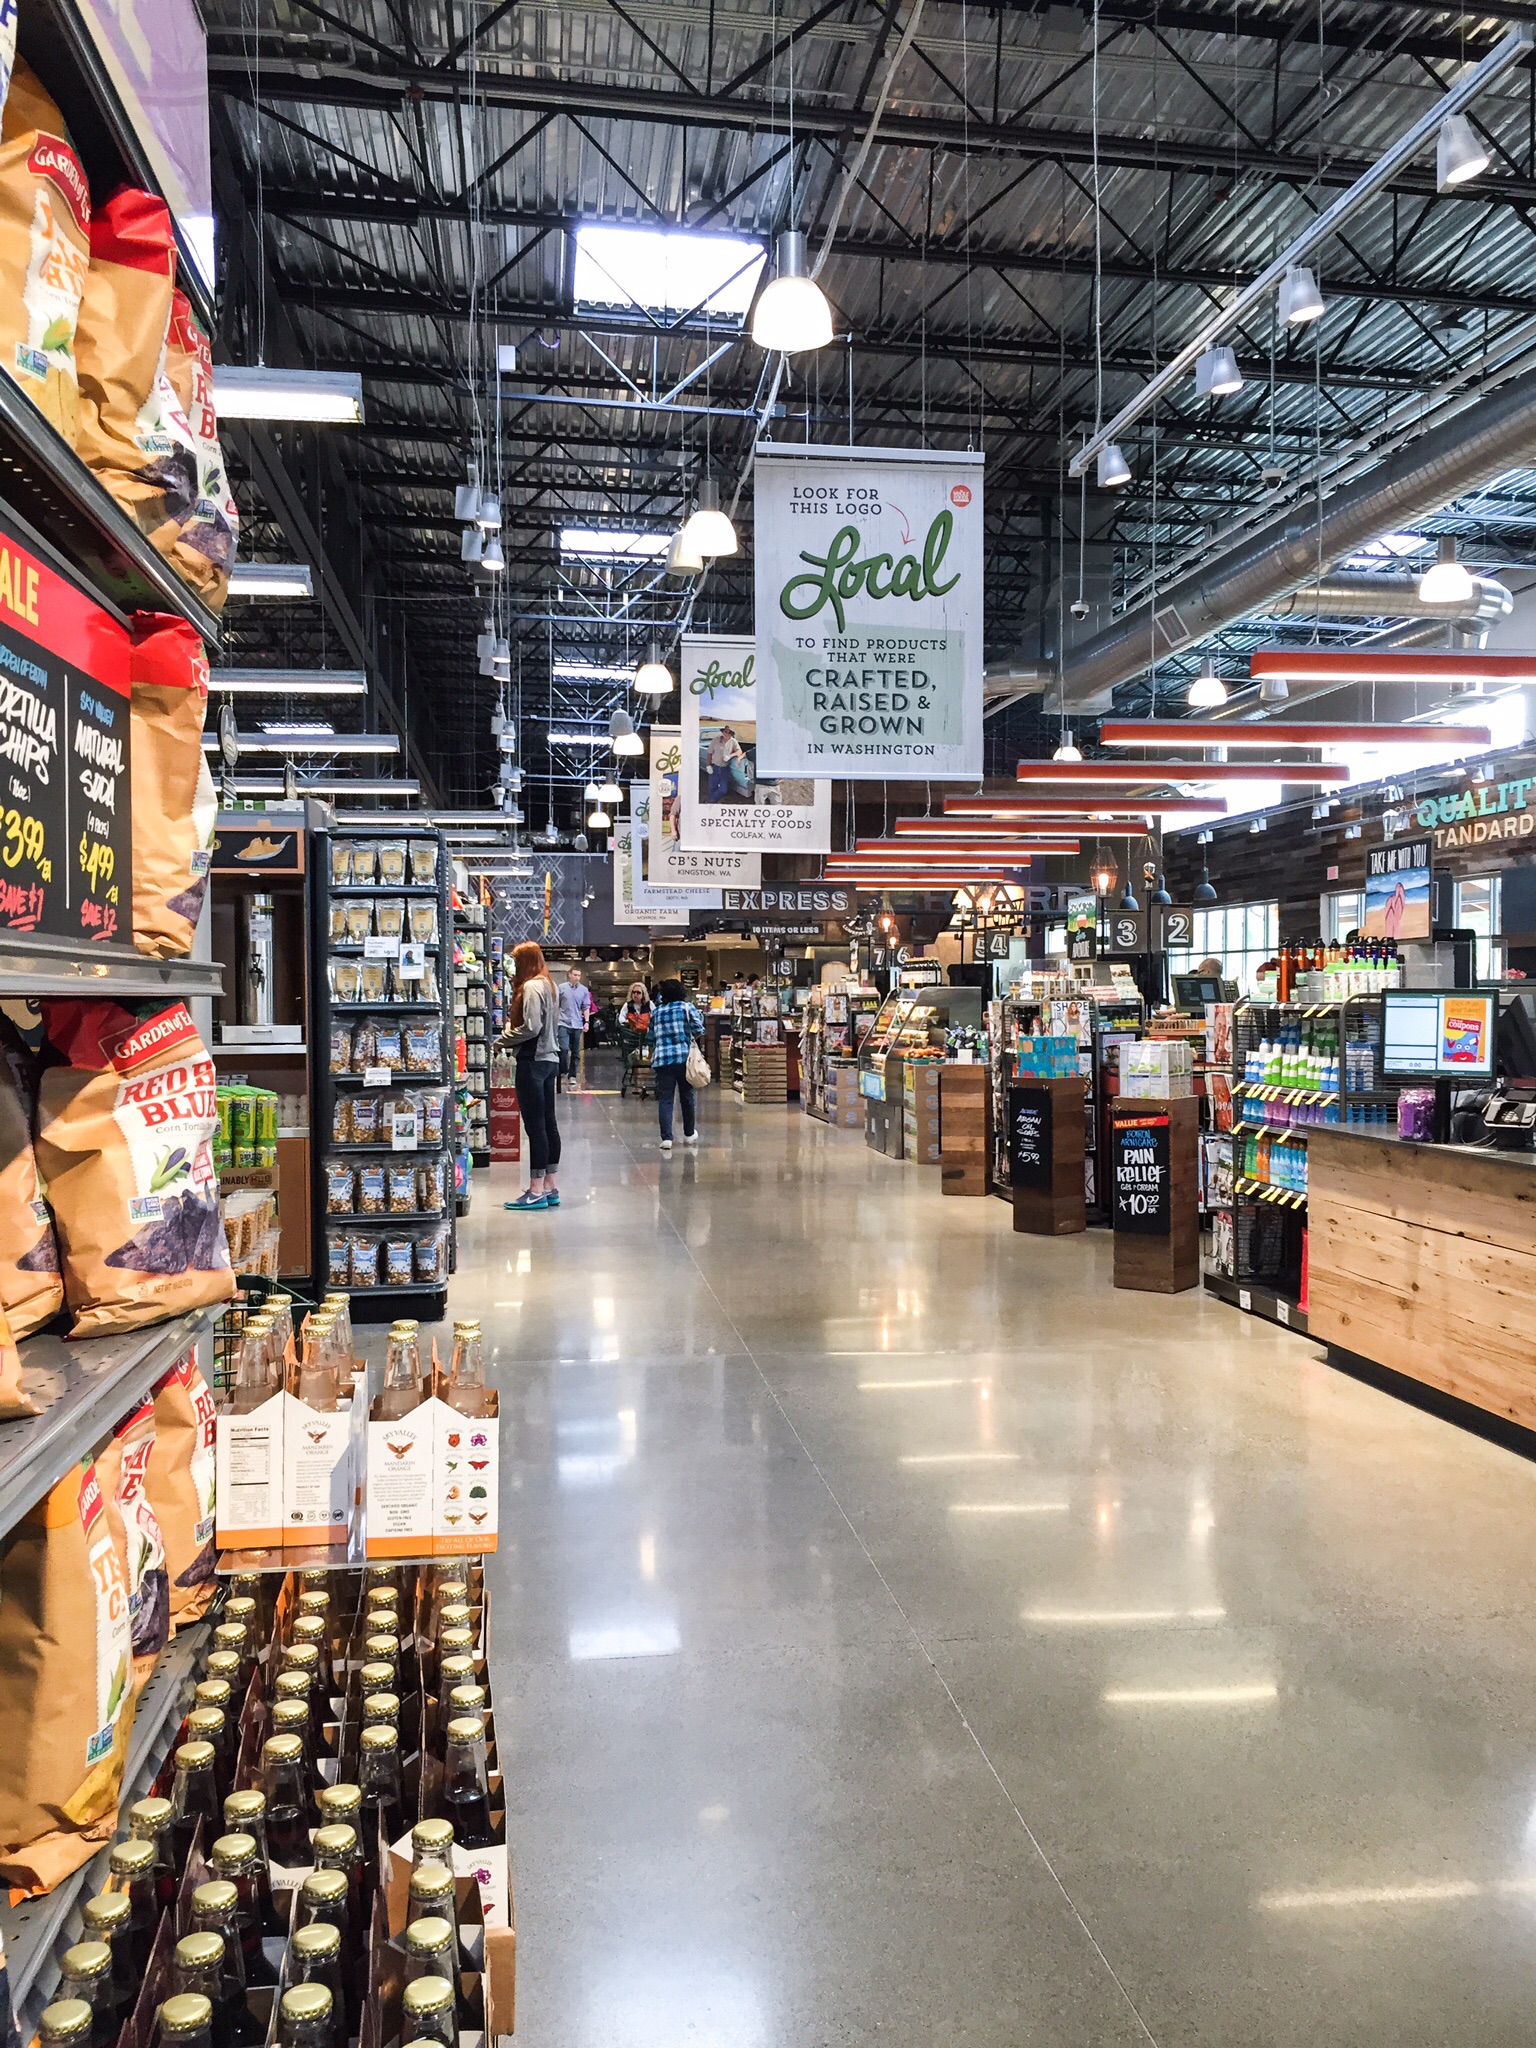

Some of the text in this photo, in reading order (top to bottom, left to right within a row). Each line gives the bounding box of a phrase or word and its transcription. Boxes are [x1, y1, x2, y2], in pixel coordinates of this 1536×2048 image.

[34, 146, 80, 189] GARDEN
[793, 486, 879, 501] LOOK FOR
[790, 501, 883, 516] THIS LOGO
[780, 510, 962, 634] Local
[796, 637, 947, 651] TO FIND PRODUCTS
[827, 652, 916, 664] THAT WERE
[689, 654, 756, 700] Local
[806, 668, 937, 691] CRAFTED,
[80, 690, 95, 716] SKY
[812, 692, 931, 713] RAISED &
[819, 714, 925, 736] GROWN
[74, 719, 125, 776] NATURAL
[807, 743, 935, 756] IN WASHINGTON
[79, 768, 115, 816] SODA
[720, 808, 793, 818] PNW CO-OP
[1417, 777, 1536, 829] QUALIT
[701, 819, 813, 830] SPECIALTY FOODS
[1426, 814, 1534, 849] TANDARD
[730, 831, 783, 840] COLFAX, WA
[668, 856, 742, 868] CB'S NUTS
[1370, 843, 1427, 875] TAKE ME WITH YOU
[677, 869, 717, 877] KINGSTON,
[724, 890, 849, 912] EXPRESS
[1116, 919, 1138, 947] 3
[1167, 913, 1189, 944] 2
[990, 933, 1008, 956] 4
[873, 947, 886, 966] 7
[896, 946, 911, 965] 6
[1054, 1001, 1089, 1012] SHPE
[1448, 1020, 1480, 1031] coupons
[114, 1018, 176, 1059] GARDEN
[120, 1066, 188, 1106] RED
[155, 1126, 181, 1135] Corn
[1114, 1119, 1139, 1128] VALUE
[1123, 1148, 1155, 1165] PAIN
[382, 1429, 419, 1441] SKY VALLEY
